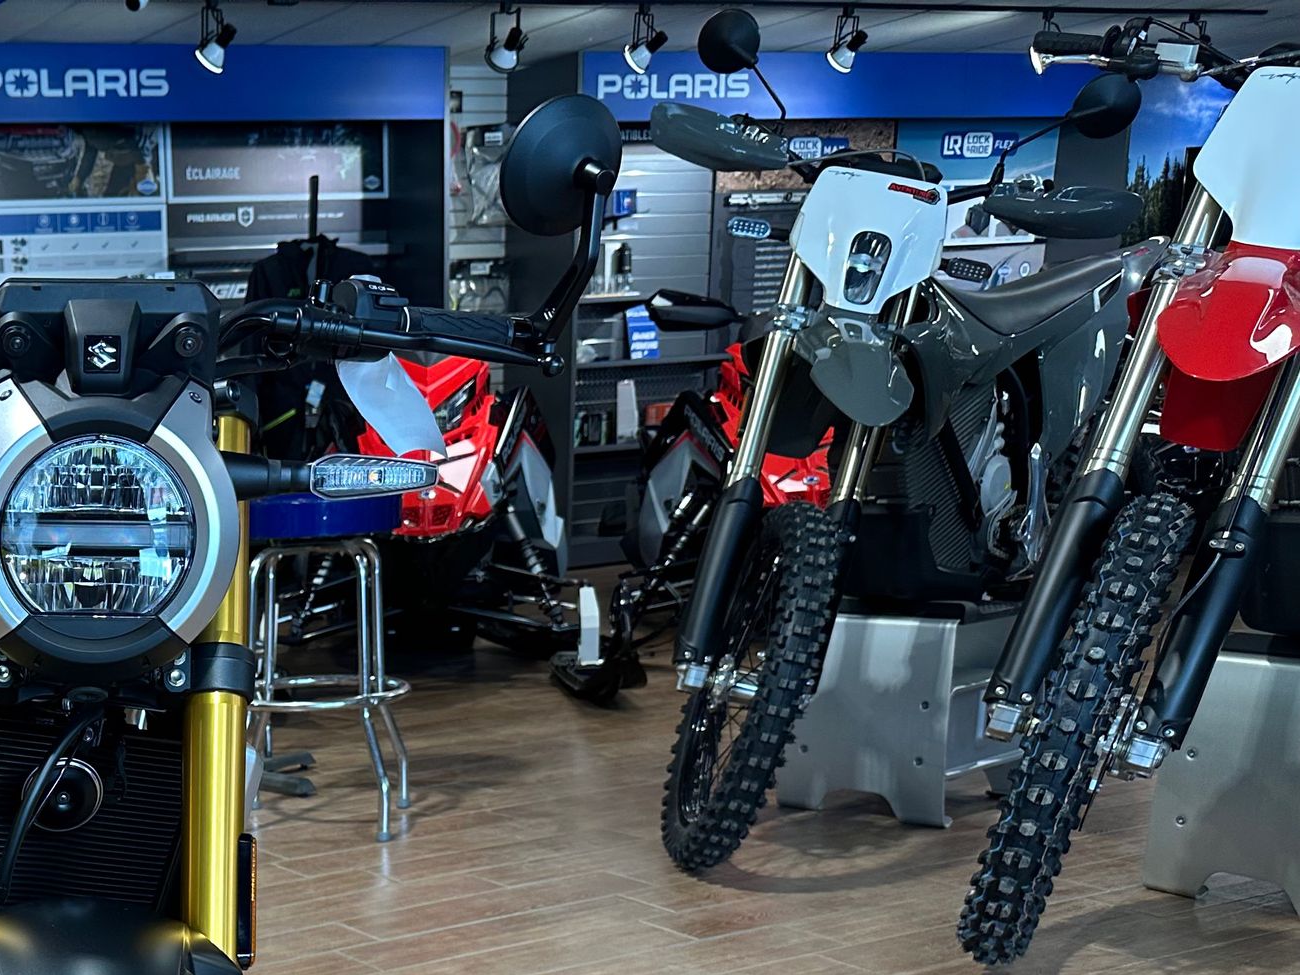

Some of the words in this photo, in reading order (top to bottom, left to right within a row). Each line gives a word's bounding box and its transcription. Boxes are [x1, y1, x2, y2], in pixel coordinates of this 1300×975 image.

[597, 73, 750, 99] POLARIS
[793, 140, 819, 150] LOCK
[967, 134, 990, 144] LOCK
[186, 166, 241, 180] ÉCLAIRAGE
[684, 404, 725, 462] POLARIS
